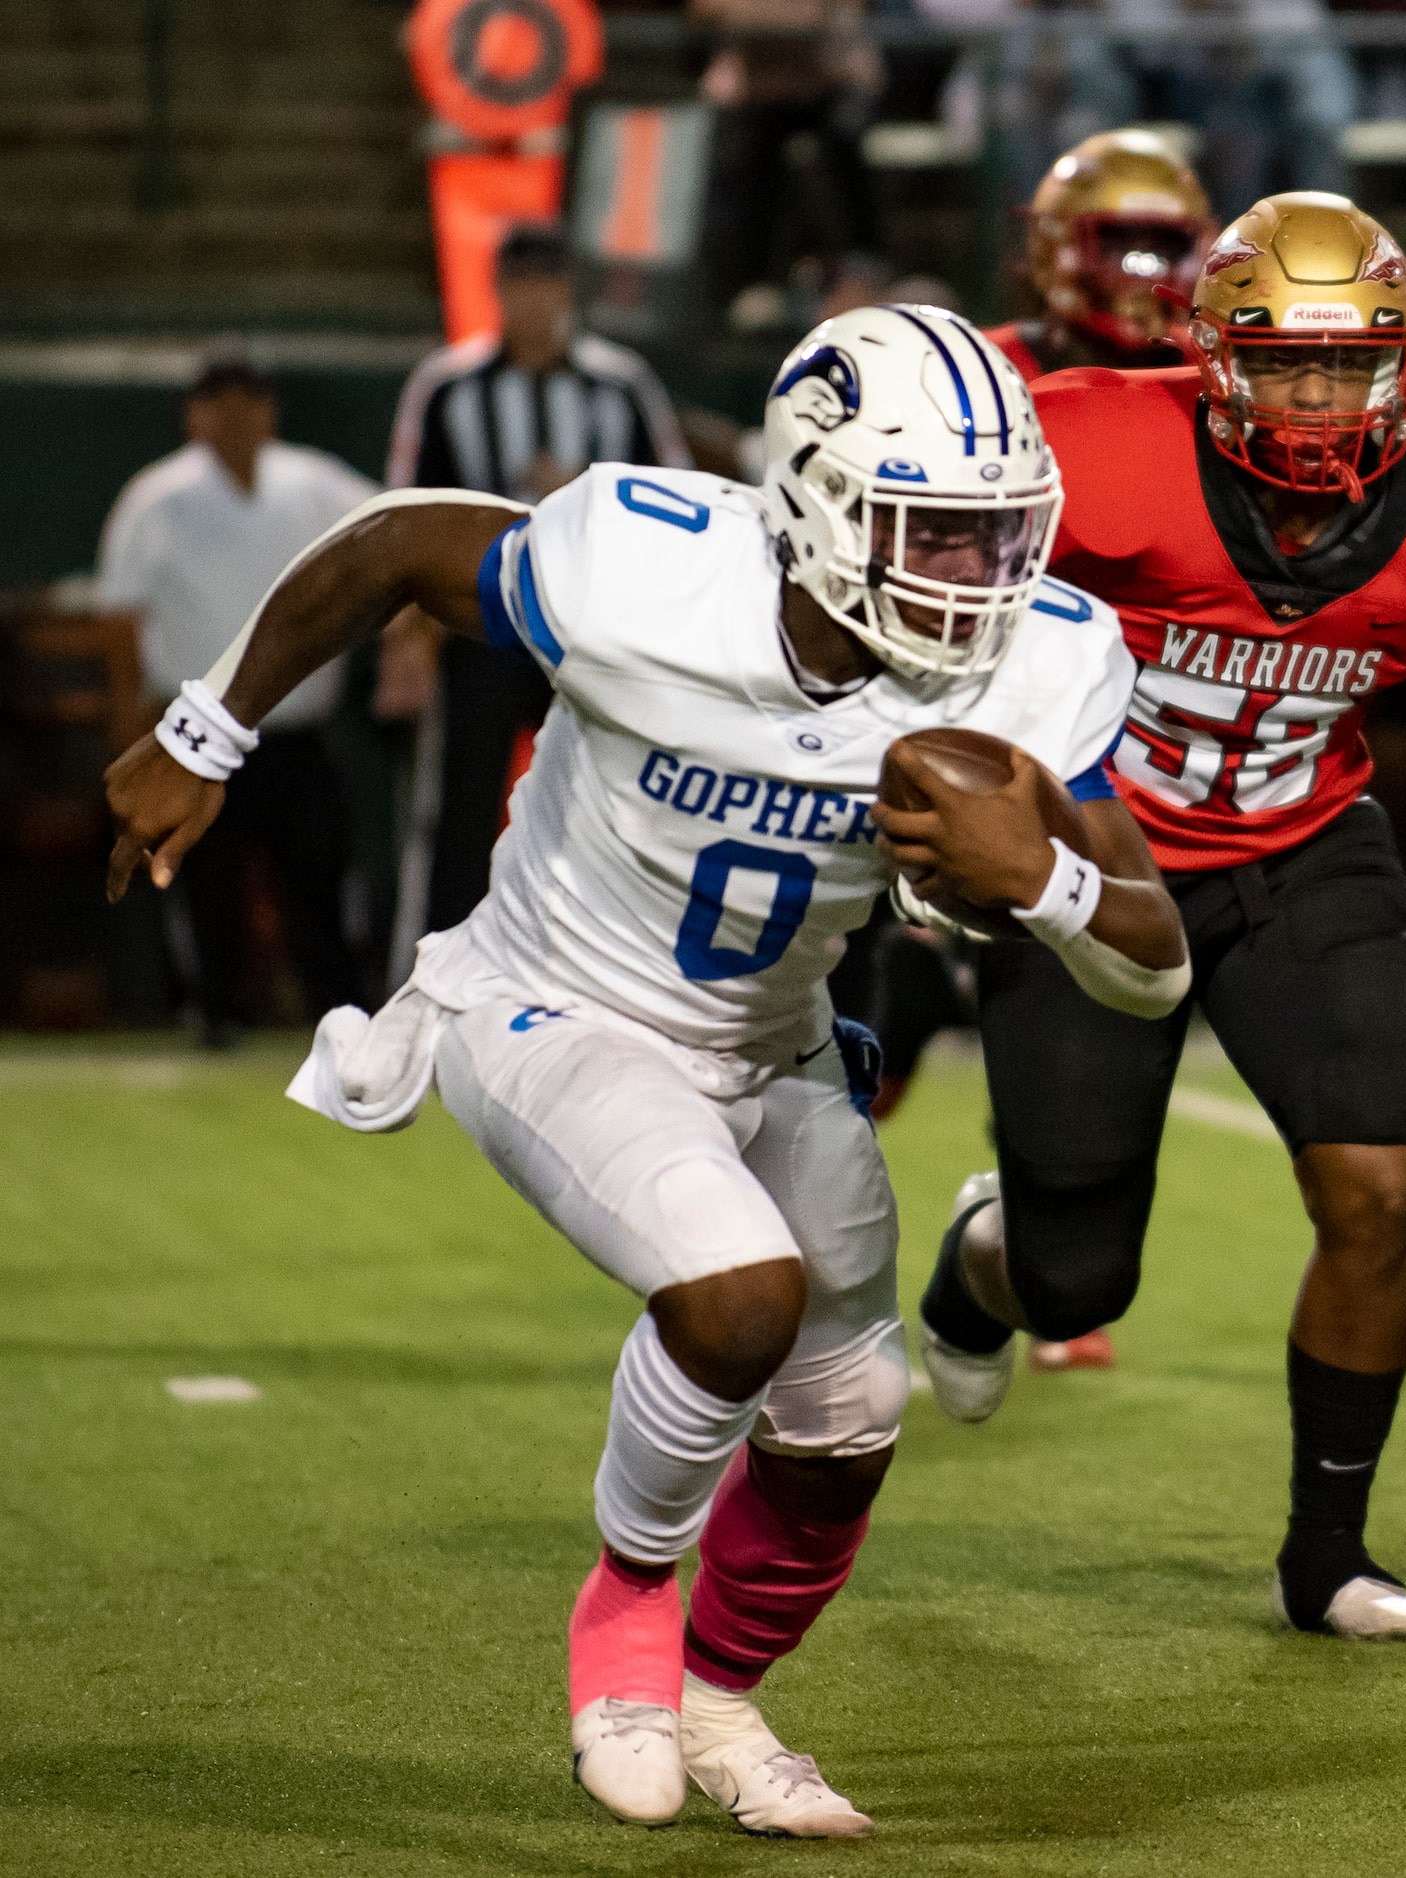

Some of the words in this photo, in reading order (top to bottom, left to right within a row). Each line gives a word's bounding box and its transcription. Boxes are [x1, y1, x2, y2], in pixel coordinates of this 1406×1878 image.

[1294, 308, 1353, 321] Riddell
[615, 478, 710, 533] 0
[1160, 622, 1383, 693] WARRIORS
[1110, 664, 1356, 815] 58
[673, 837, 818, 981] 0
